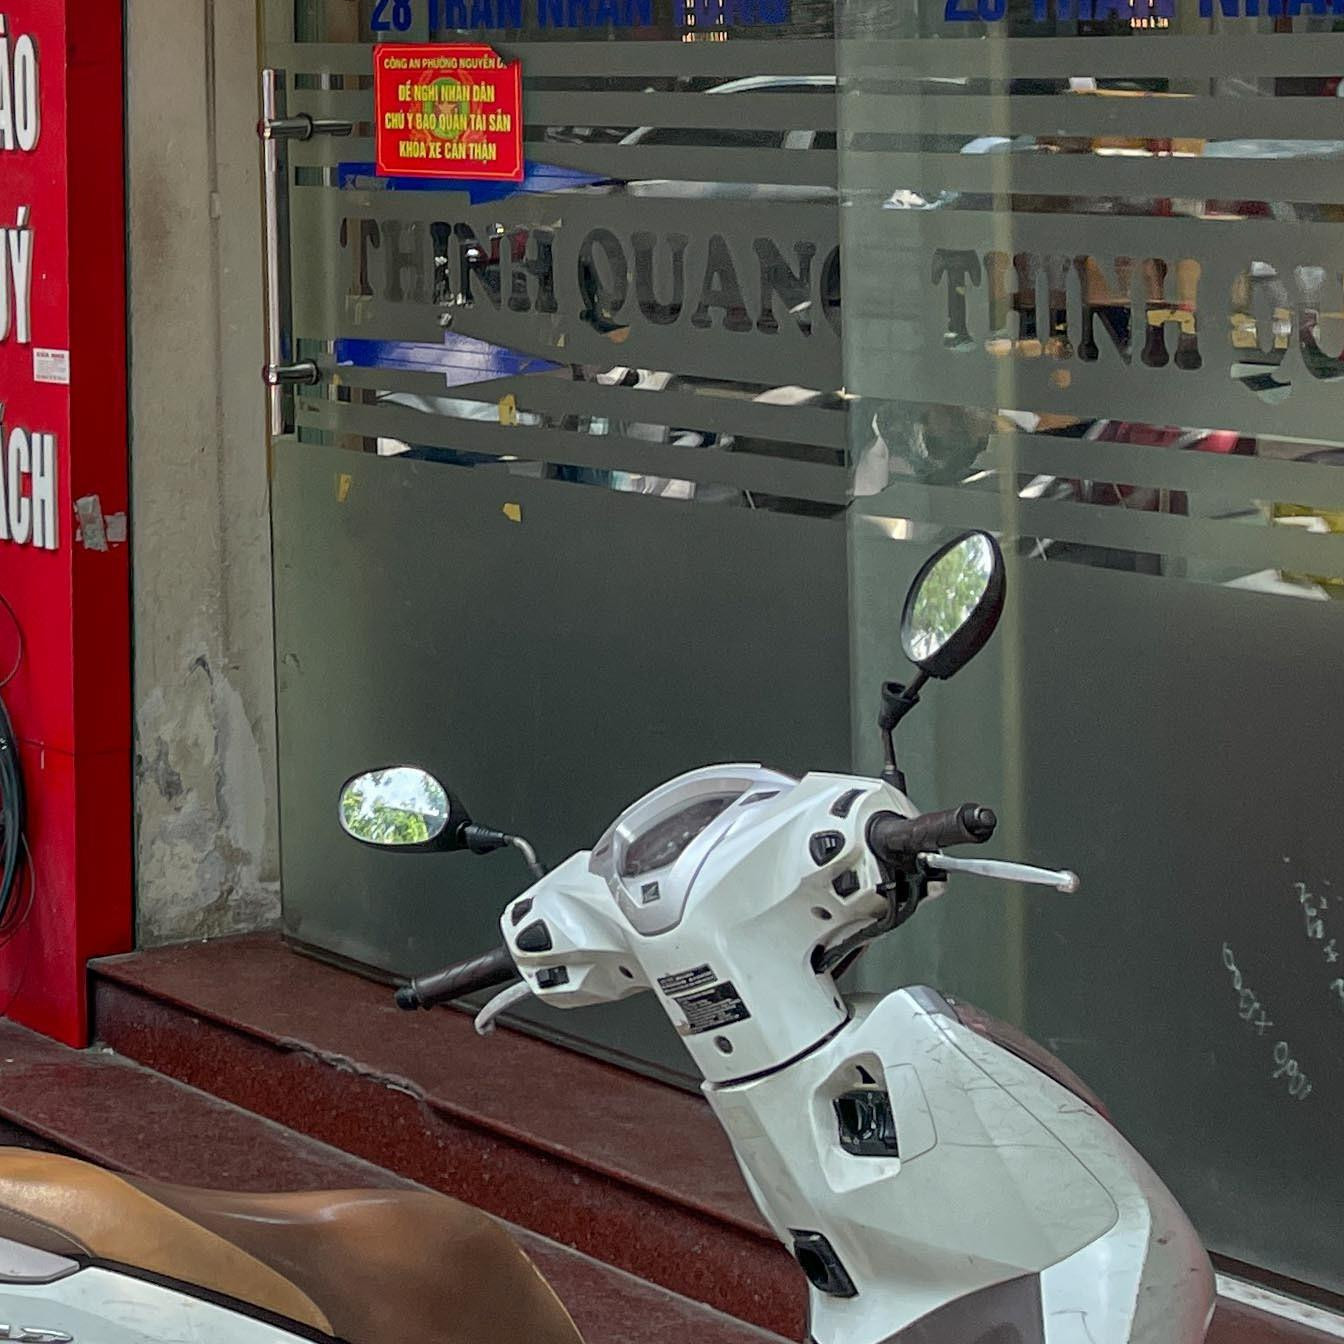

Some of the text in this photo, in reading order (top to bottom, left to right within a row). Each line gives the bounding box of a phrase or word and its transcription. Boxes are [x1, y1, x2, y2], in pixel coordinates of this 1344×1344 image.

[384, 55, 408, 69] CÔNG
[409, 58, 421, 69] AN
[440, 82, 470, 102] NHÂN
[472, 81, 495, 103] DÂN
[385, 110, 404, 129] CHÚ
[429, 142, 443, 159] XE
